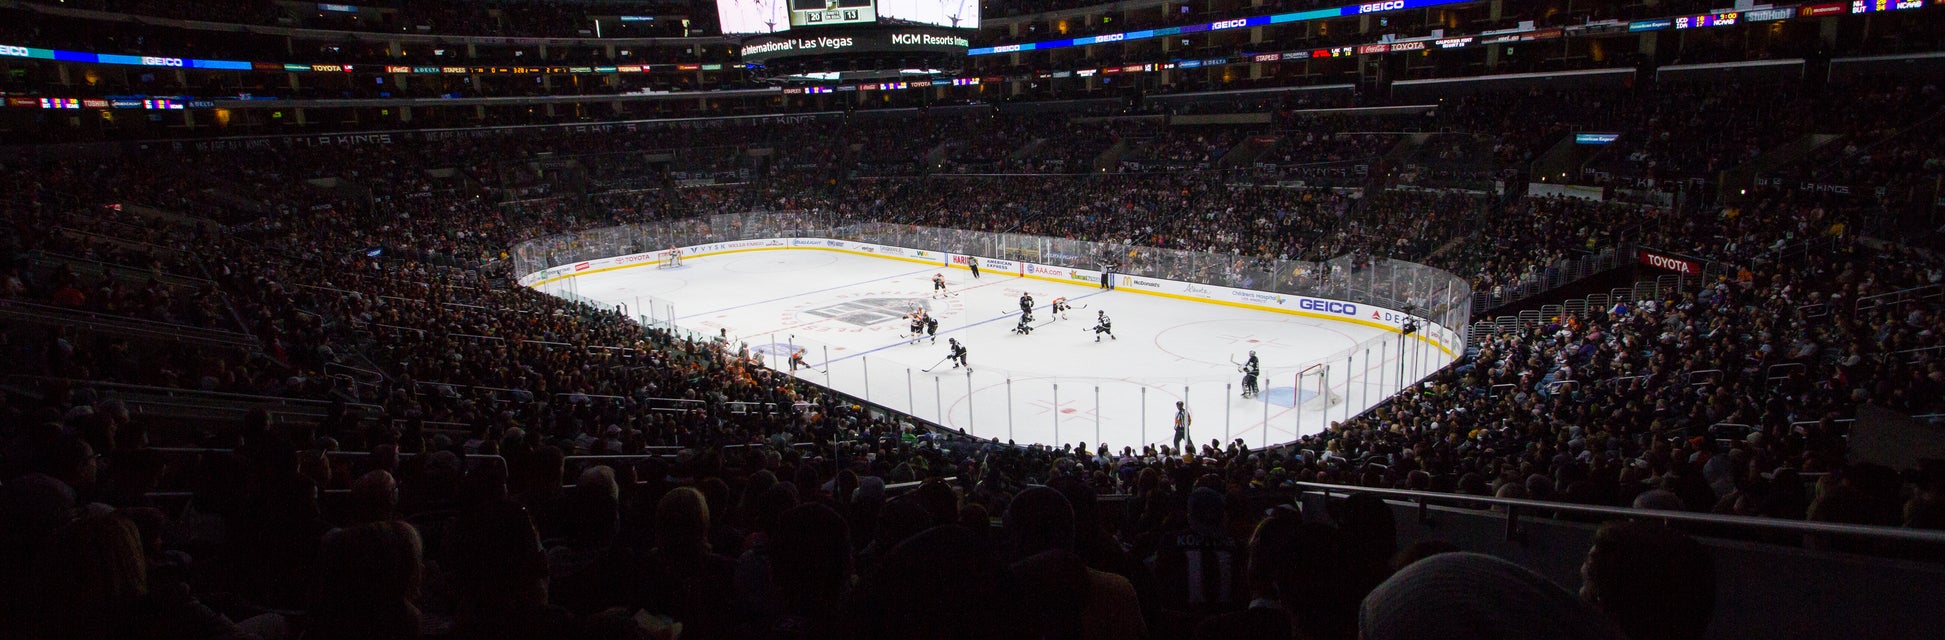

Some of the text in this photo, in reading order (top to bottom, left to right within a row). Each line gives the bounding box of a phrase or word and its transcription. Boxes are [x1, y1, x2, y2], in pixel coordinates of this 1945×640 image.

[1363, 0, 1404, 13] GEICO
[811, 12, 821, 21] 20
[847, 10, 857, 20] 13
[1748, 8, 1791, 22] StubHub!
[1214, 19, 1246, 30] GEICO
[799, 39, 818, 49] Las
[818, 37, 853, 50] Vegas
[892, 34, 921, 45] MGM
[924, 34, 954, 45] Resorts
[1098, 34, 1123, 43] GEICO
[996, 45, 1020, 53] GEICO
[1392, 42, 1425, 51] TOYOTA
[146, 56, 183, 67] GEICO
[337, 133, 392, 145] KINGS
[625, 254, 650, 264] TOYOTA
[953, 255, 969, 265] HARI
[987, 259, 1013, 267] AMERICAN
[1648, 254, 1690, 273] TOYOTA
[1036, 266, 1063, 277] AAA.com
[1300, 298, 1356, 316] GEICO
